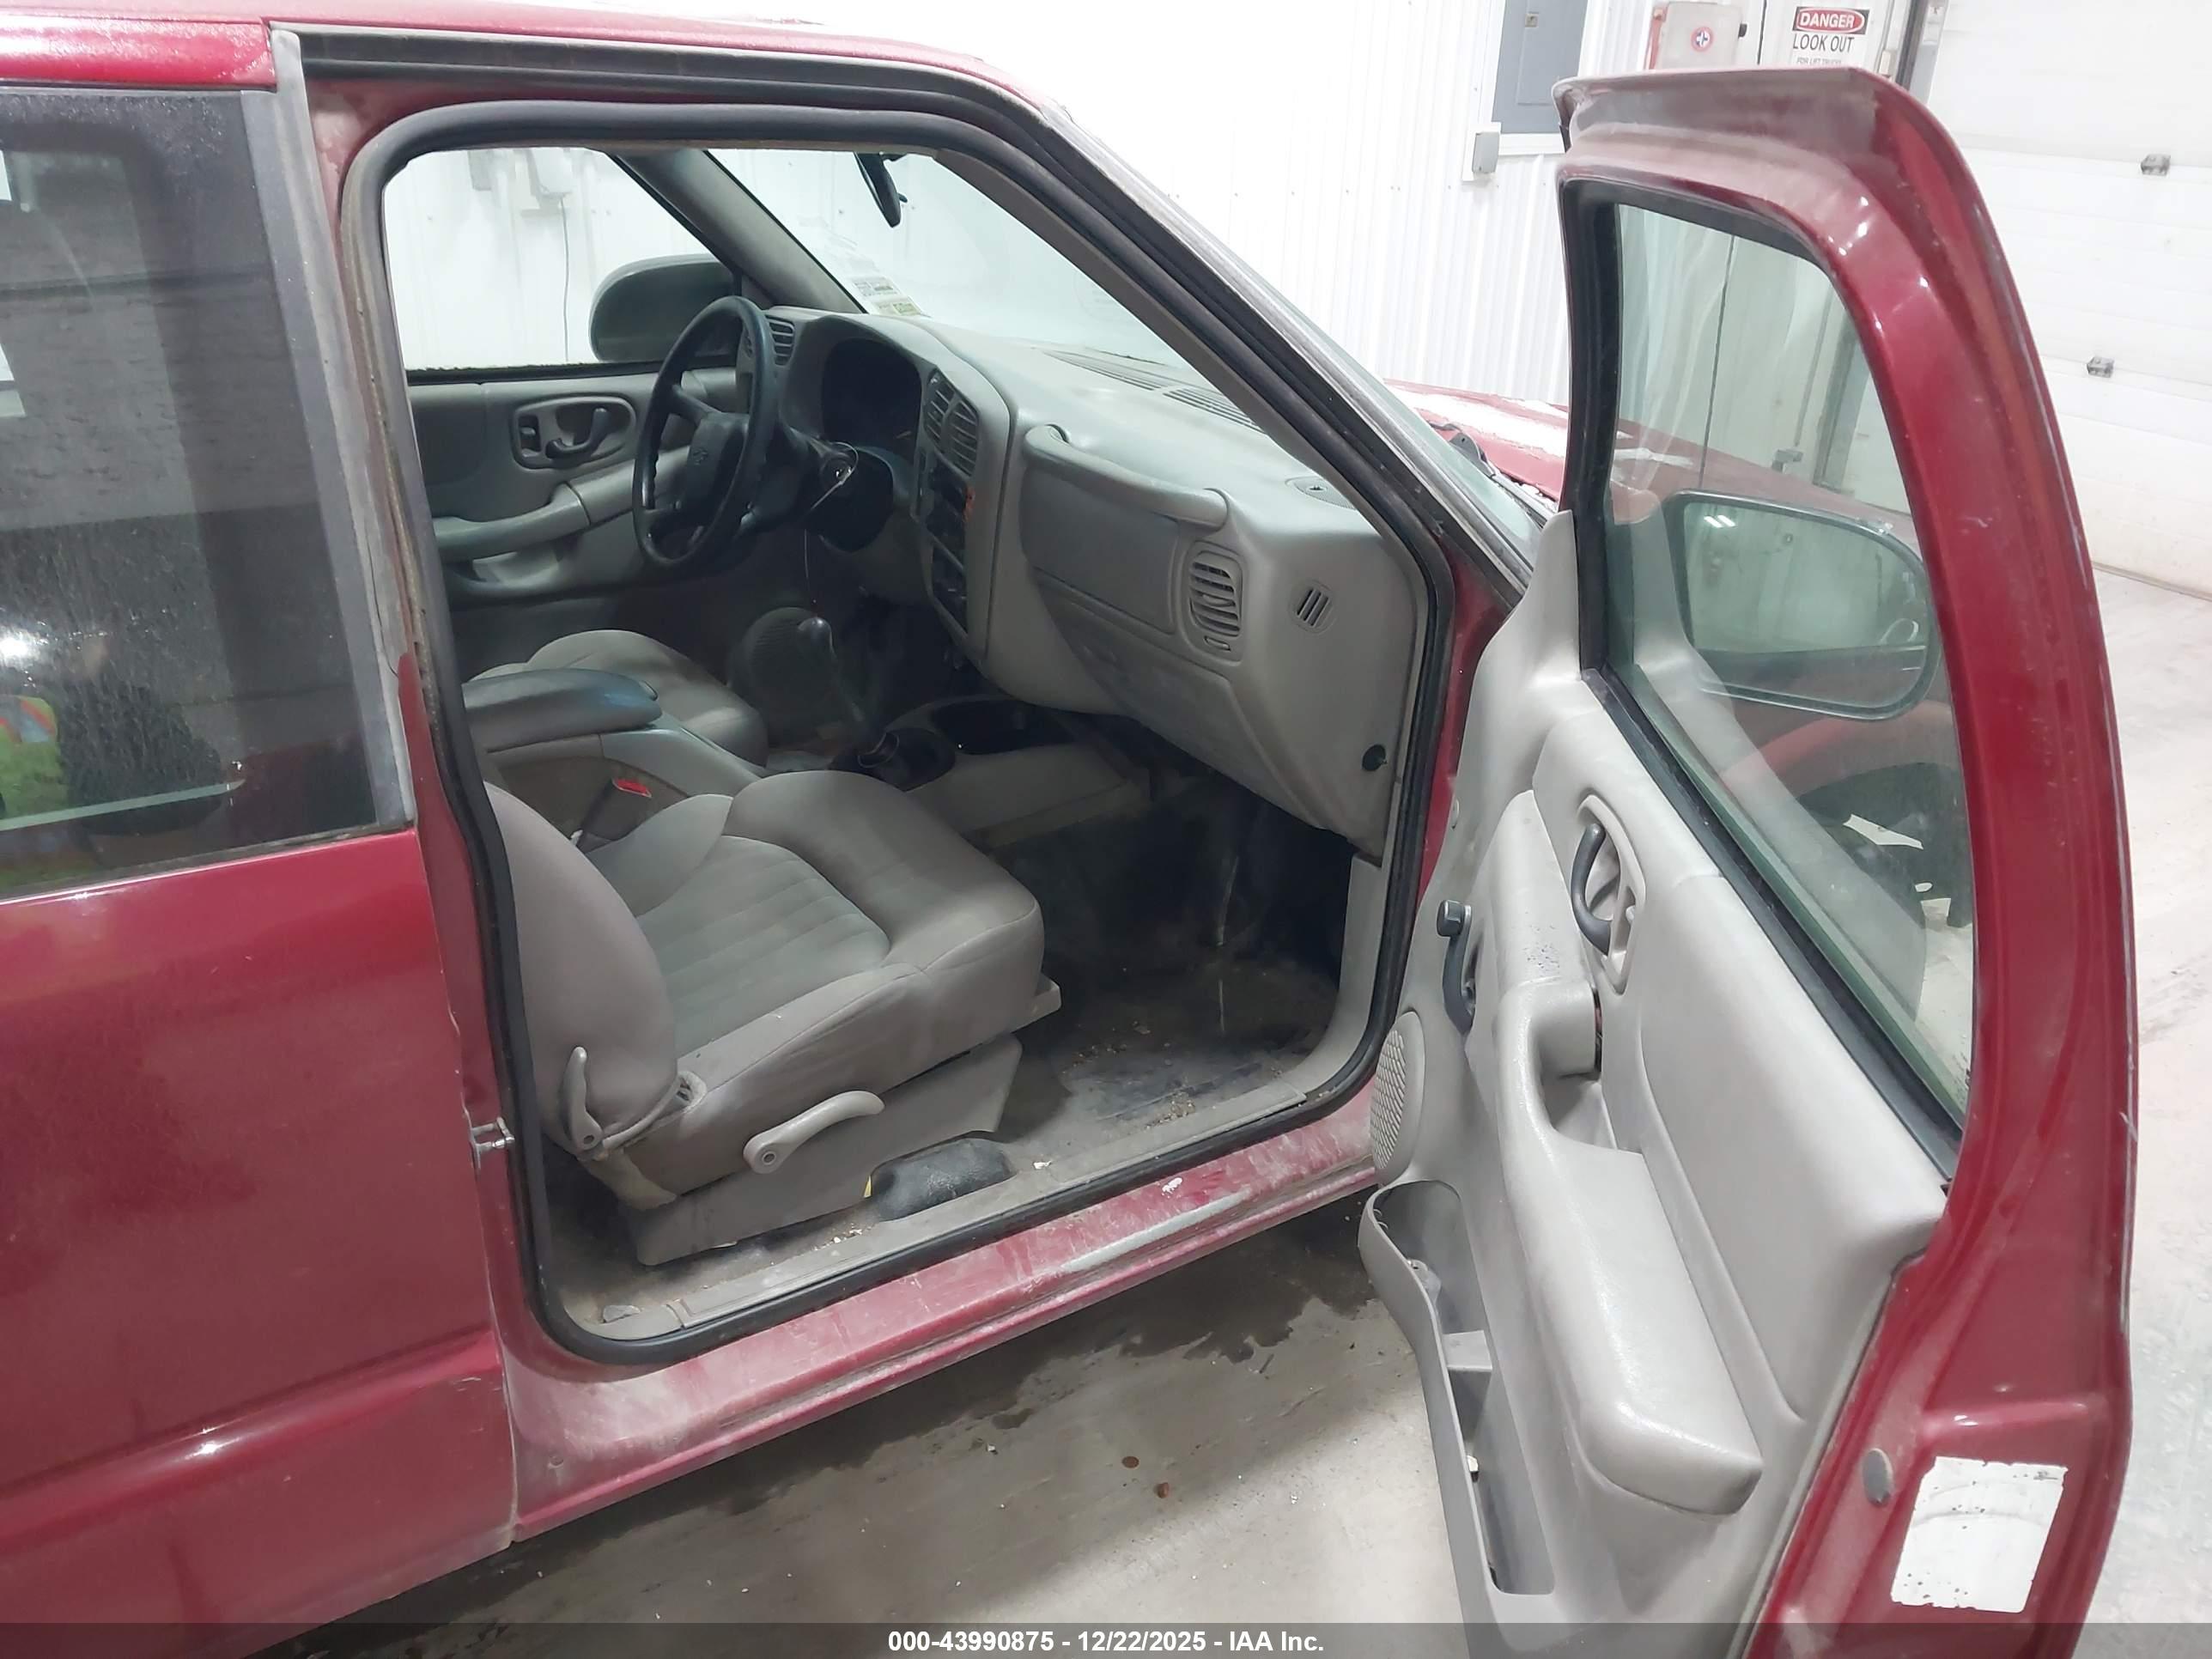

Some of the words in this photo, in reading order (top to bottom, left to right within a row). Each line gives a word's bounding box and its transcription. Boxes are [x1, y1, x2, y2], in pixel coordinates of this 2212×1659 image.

[1799, 12, 1855, 28] DANGER
[1793, 33, 1827, 52] LOOK
[1831, 35, 1855, 52] OUT
